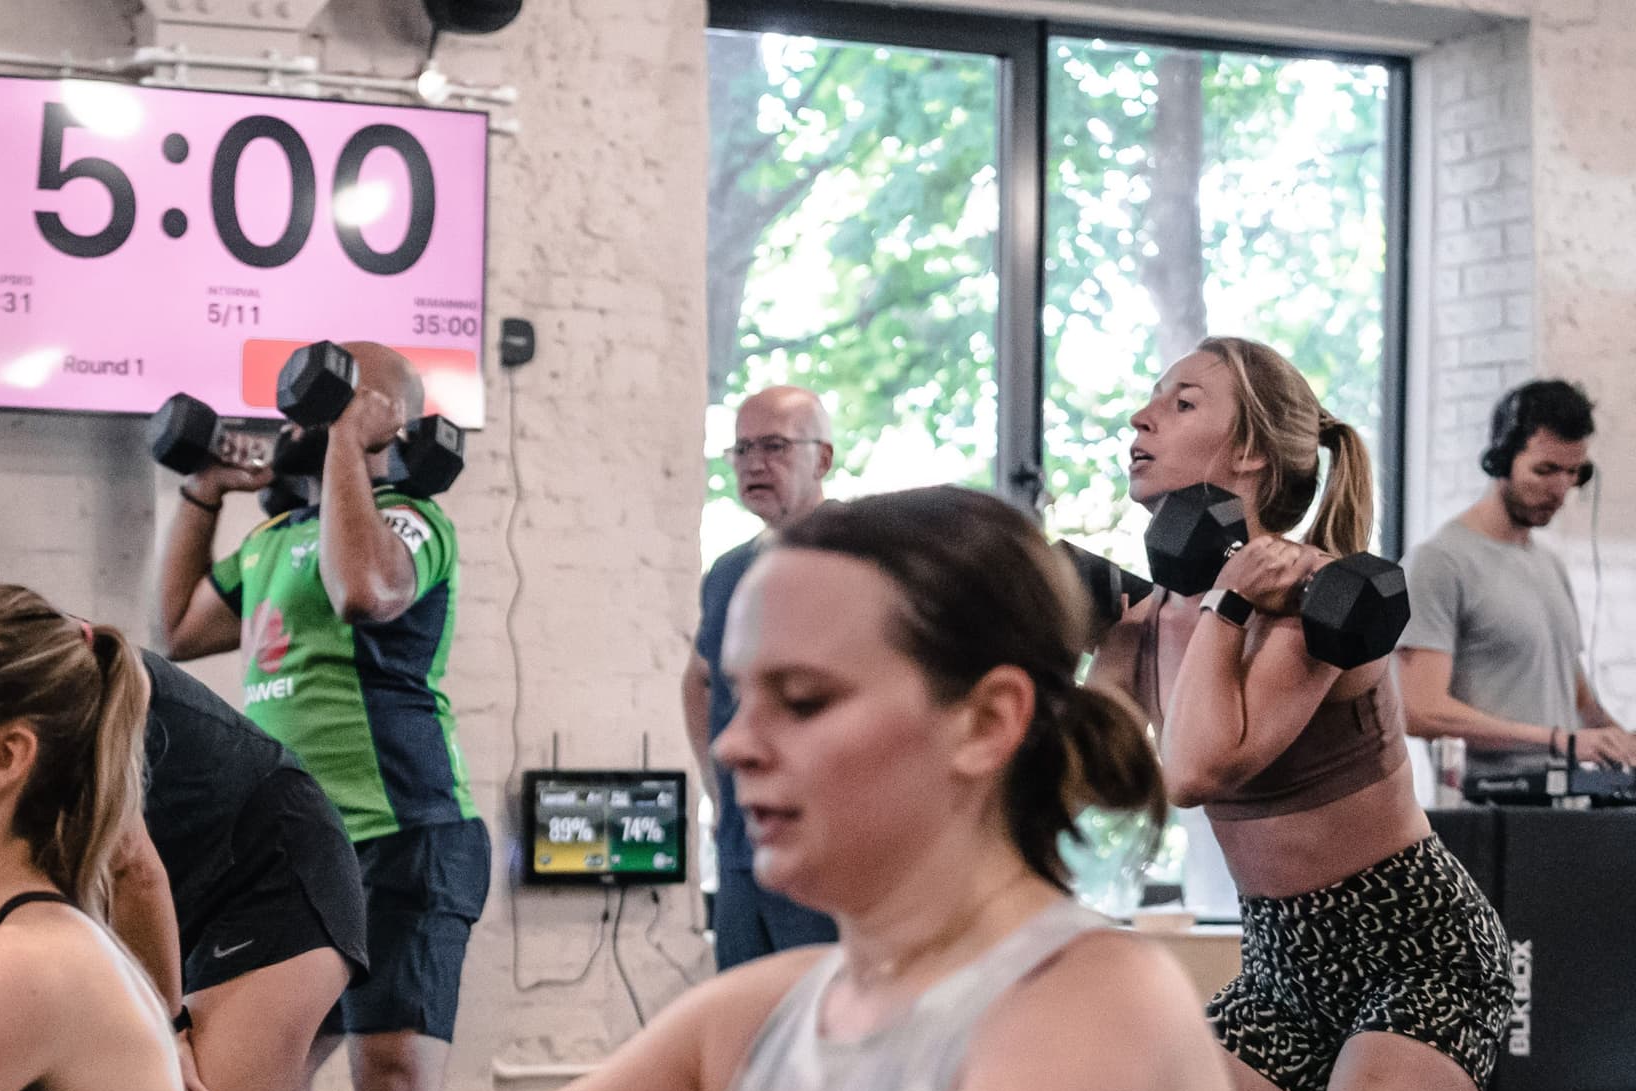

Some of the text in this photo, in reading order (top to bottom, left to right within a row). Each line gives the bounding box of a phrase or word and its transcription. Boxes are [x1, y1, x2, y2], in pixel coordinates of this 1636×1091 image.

[34, 101, 436, 277] 5:00
[208, 302, 260, 327] 5/11
[412, 314, 477, 337] 35:00
[63, 355, 143, 377] Round 1
[244, 676, 294, 706] AWEI
[620, 816, 665, 842] 74%
